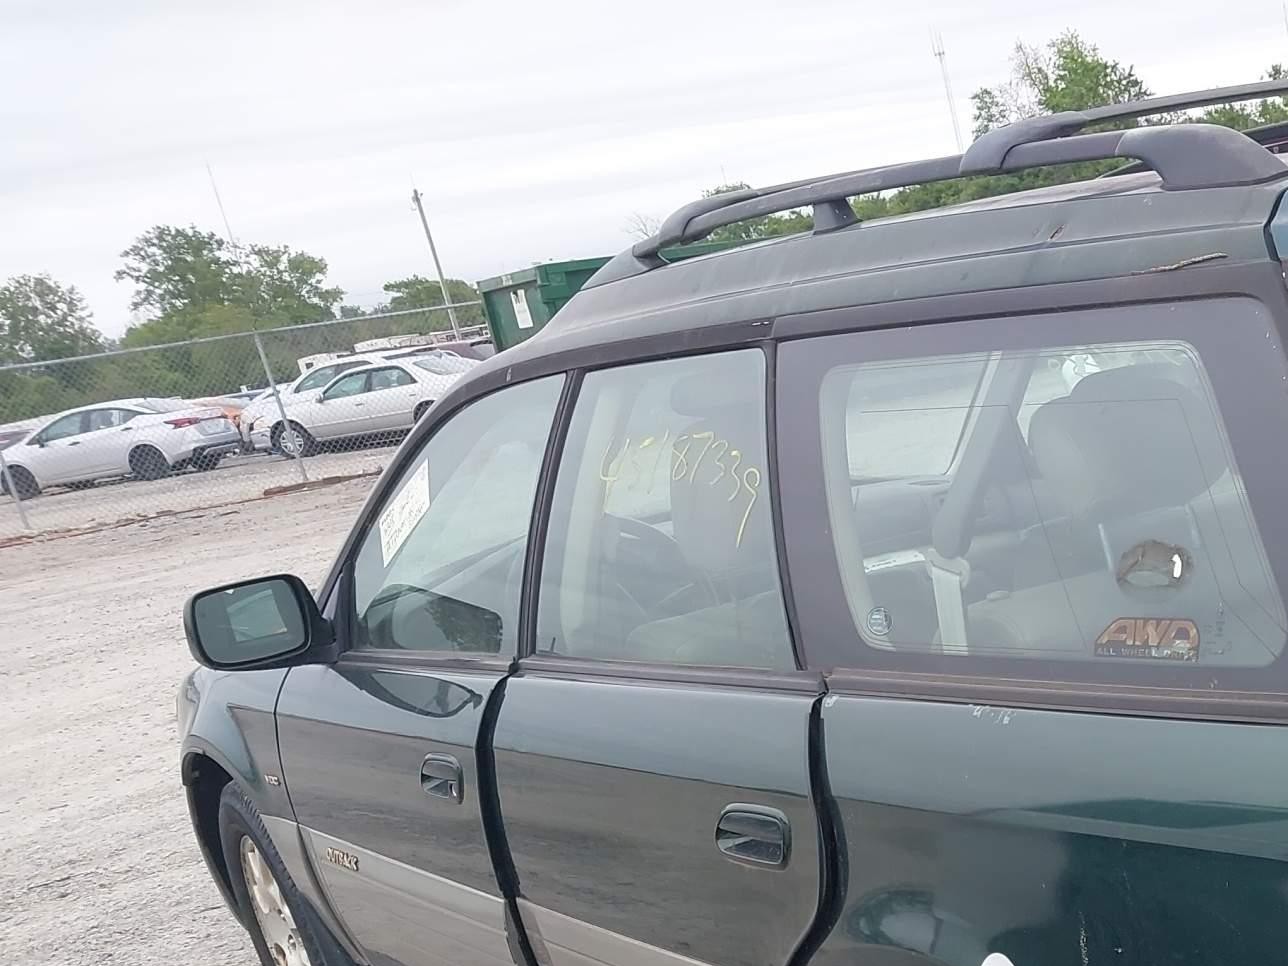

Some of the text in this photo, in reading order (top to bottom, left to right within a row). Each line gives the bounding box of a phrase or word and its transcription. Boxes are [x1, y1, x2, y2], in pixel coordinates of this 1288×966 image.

[1096, 619, 1198, 646] AWD
[1097, 647, 1116, 656] ALL
[326, 847, 359, 872] OUTBACK
